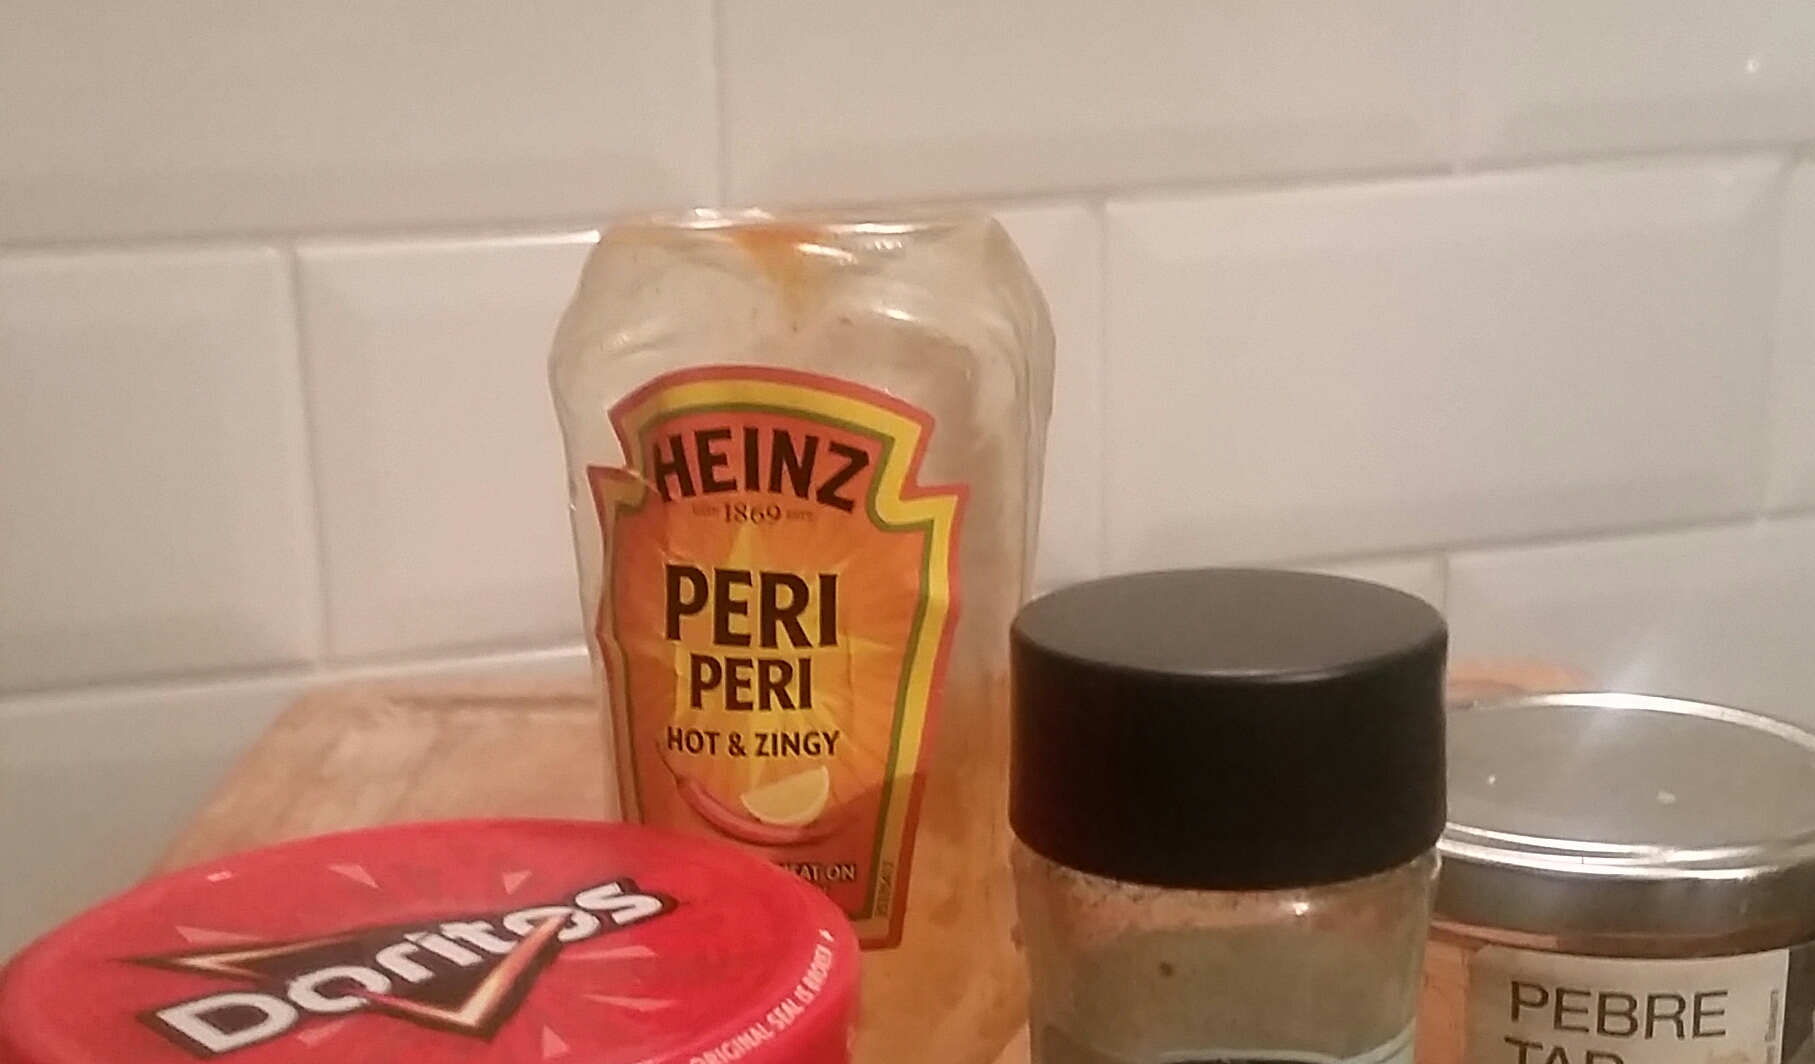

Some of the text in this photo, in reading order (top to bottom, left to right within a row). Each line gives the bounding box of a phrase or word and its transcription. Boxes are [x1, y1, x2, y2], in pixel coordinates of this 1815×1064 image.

[653, 426, 869, 512] HEINZ
[724, 502, 781, 525] 1869
[664, 563, 838, 650] PERI
[689, 653, 814, 712] PERI
[667, 725, 841, 757] HOT & ZINGY
[826, 862, 855, 881] ON
[155, 881, 664, 1054] Doritos
[766, 997, 805, 1032] SEAL
[1510, 980, 1728, 1040] PEBRE
